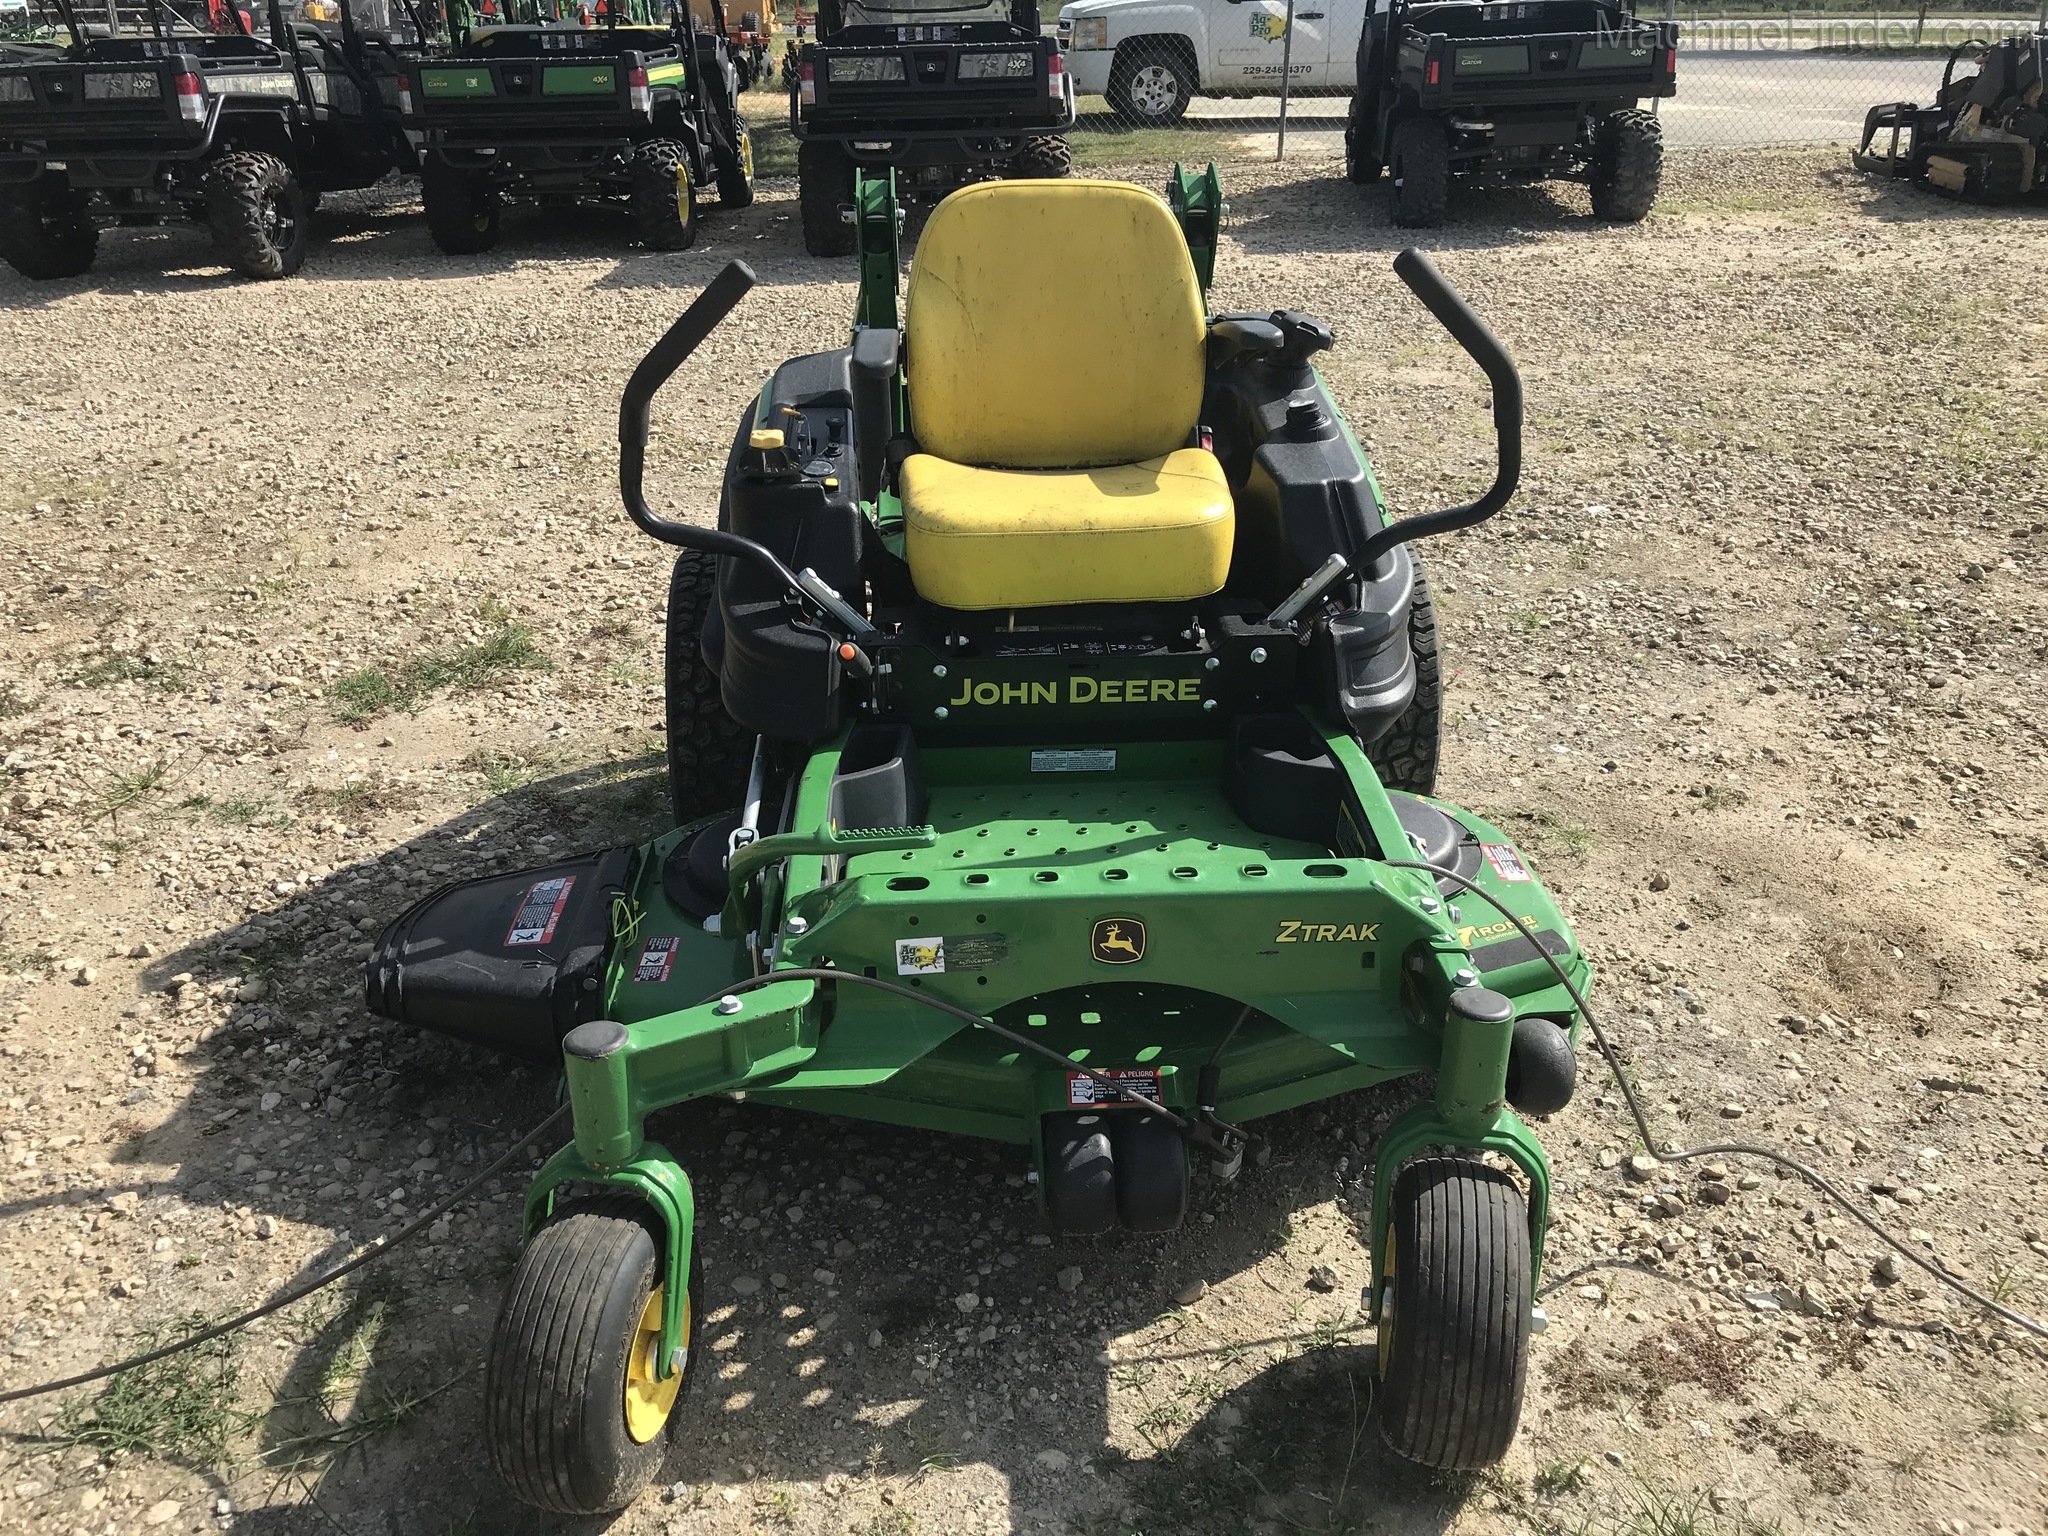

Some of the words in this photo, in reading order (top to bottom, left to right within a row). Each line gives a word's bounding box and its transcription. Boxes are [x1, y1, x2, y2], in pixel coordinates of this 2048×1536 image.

[1251, 25, 1271, 36] Pro
[951, 678, 1057, 706] JOHN
[1069, 677, 1201, 703] DEERE
[1275, 920, 1381, 943] ZTRAK
[901, 954, 922, 965] Pro
[1127, 1070, 1154, 1078] PELIGRO
